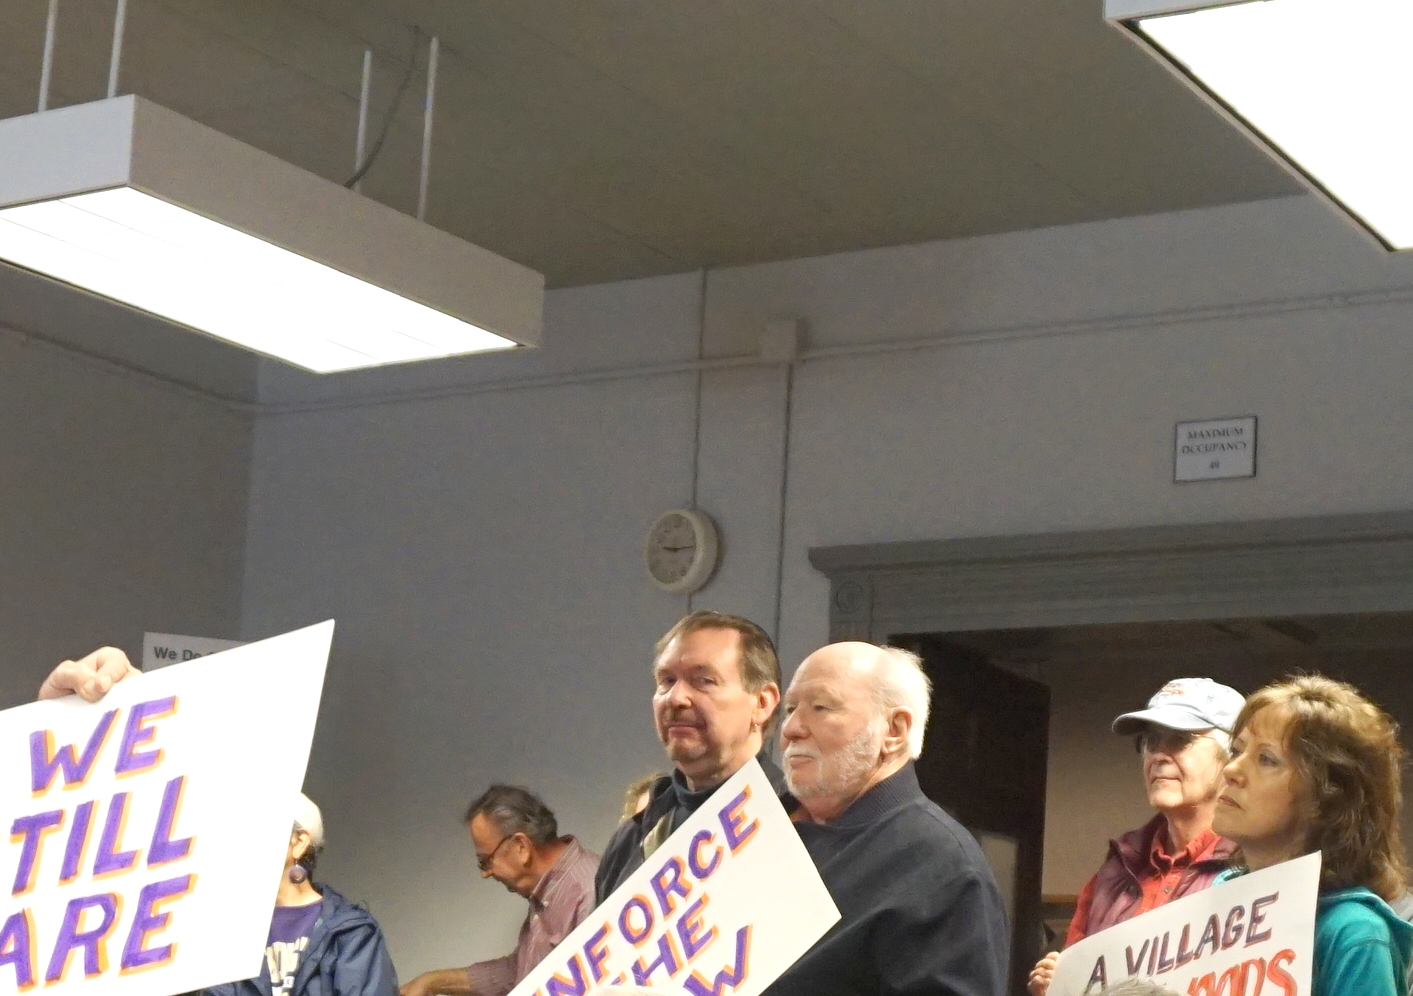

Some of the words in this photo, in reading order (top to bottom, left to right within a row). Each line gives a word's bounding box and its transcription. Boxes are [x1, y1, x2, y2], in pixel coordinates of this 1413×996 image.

[1181, 441, 1247, 455] OCCUPANCY
[1188, 427, 1244, 440] MAXIMUM
[154, 646, 177, 660] We
[29, 695, 180, 798] WE
[611, 891, 720, 987] HE
[1083, 954, 1108, 996] A
[1125, 891, 1280, 976] VILLAGE
